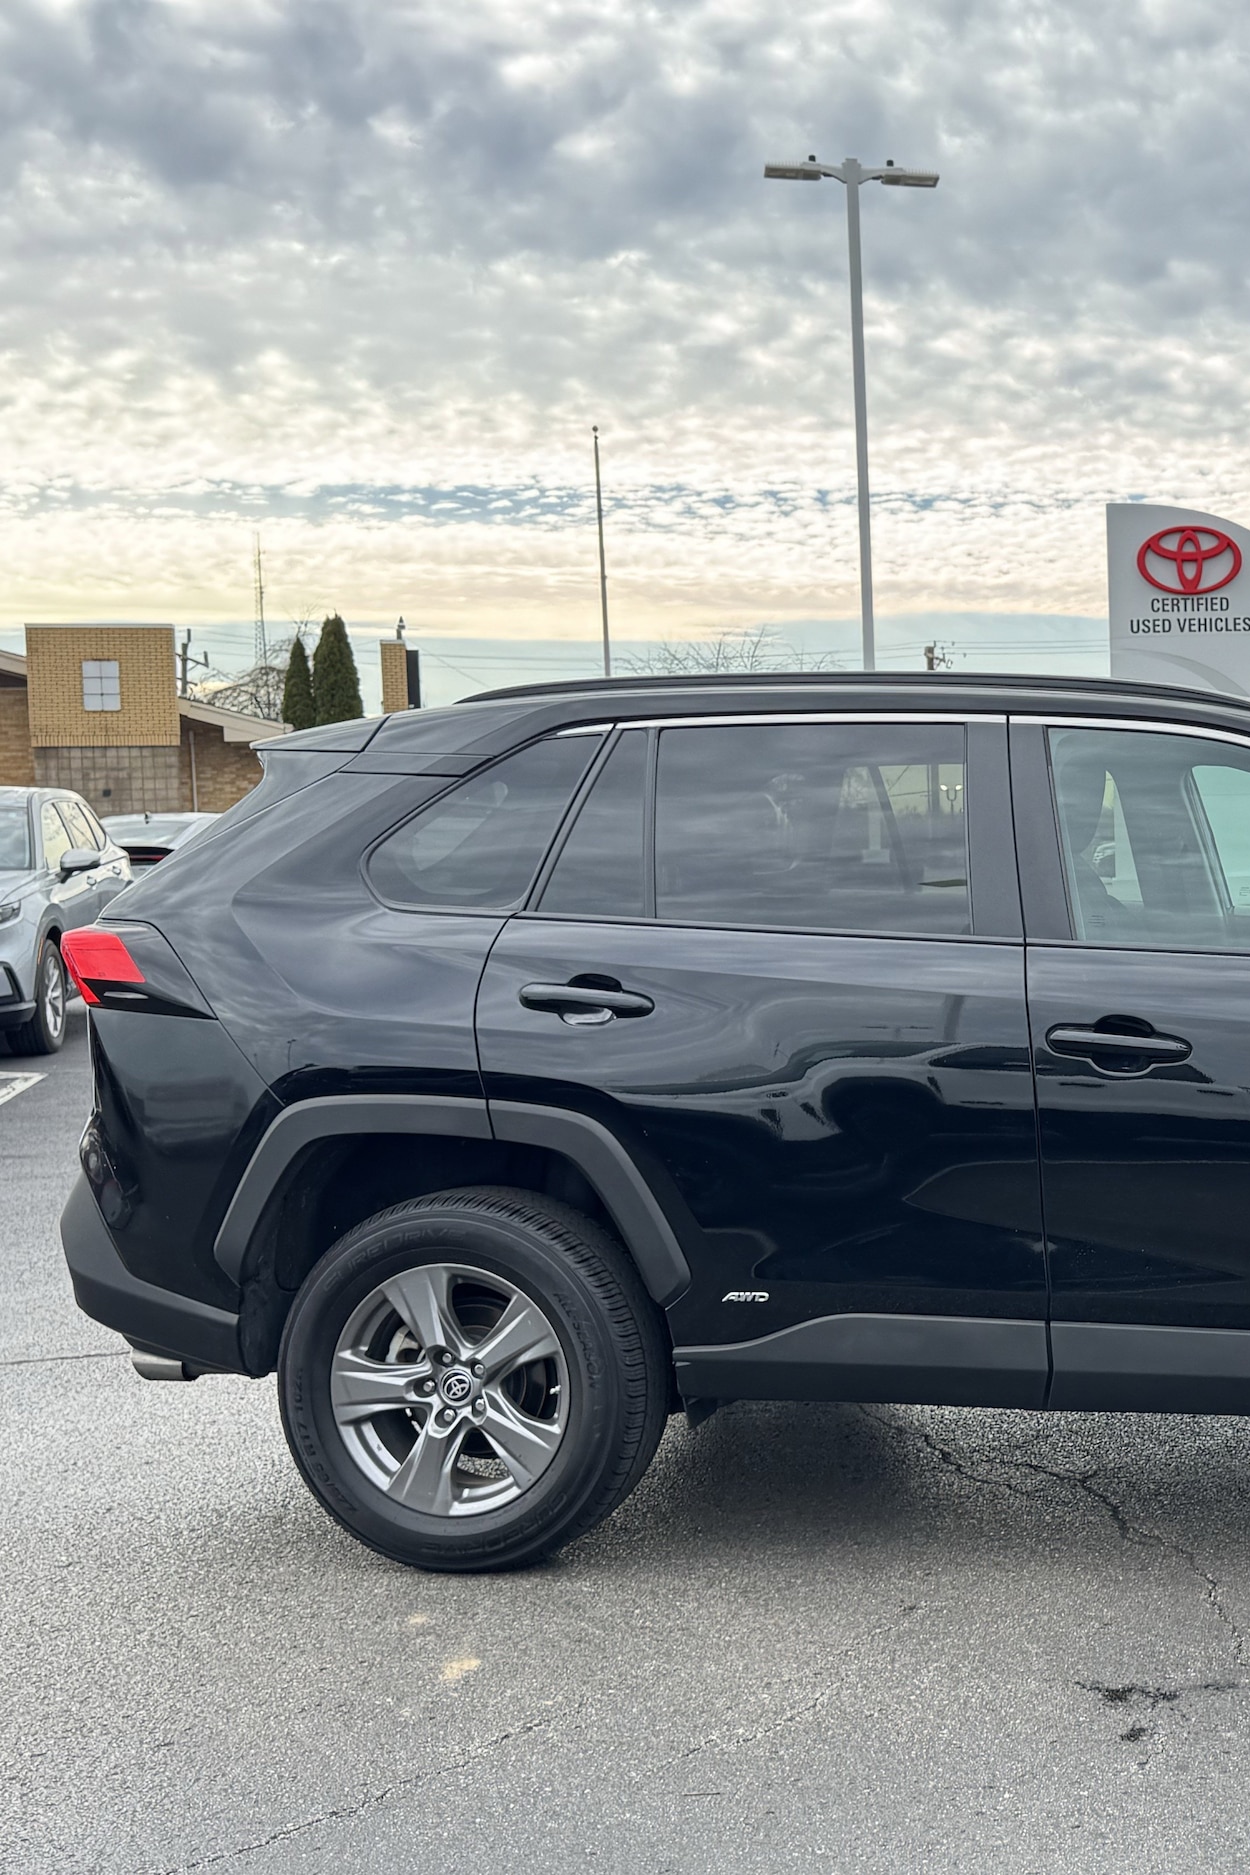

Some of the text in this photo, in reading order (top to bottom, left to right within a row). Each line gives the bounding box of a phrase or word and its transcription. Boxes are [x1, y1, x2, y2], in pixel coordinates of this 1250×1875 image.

[1151, 597, 1229, 612] CERTIFIED
[1130, 617, 1250, 633] USED VEHICLES
[722, 1291, 769, 1302] AWD
